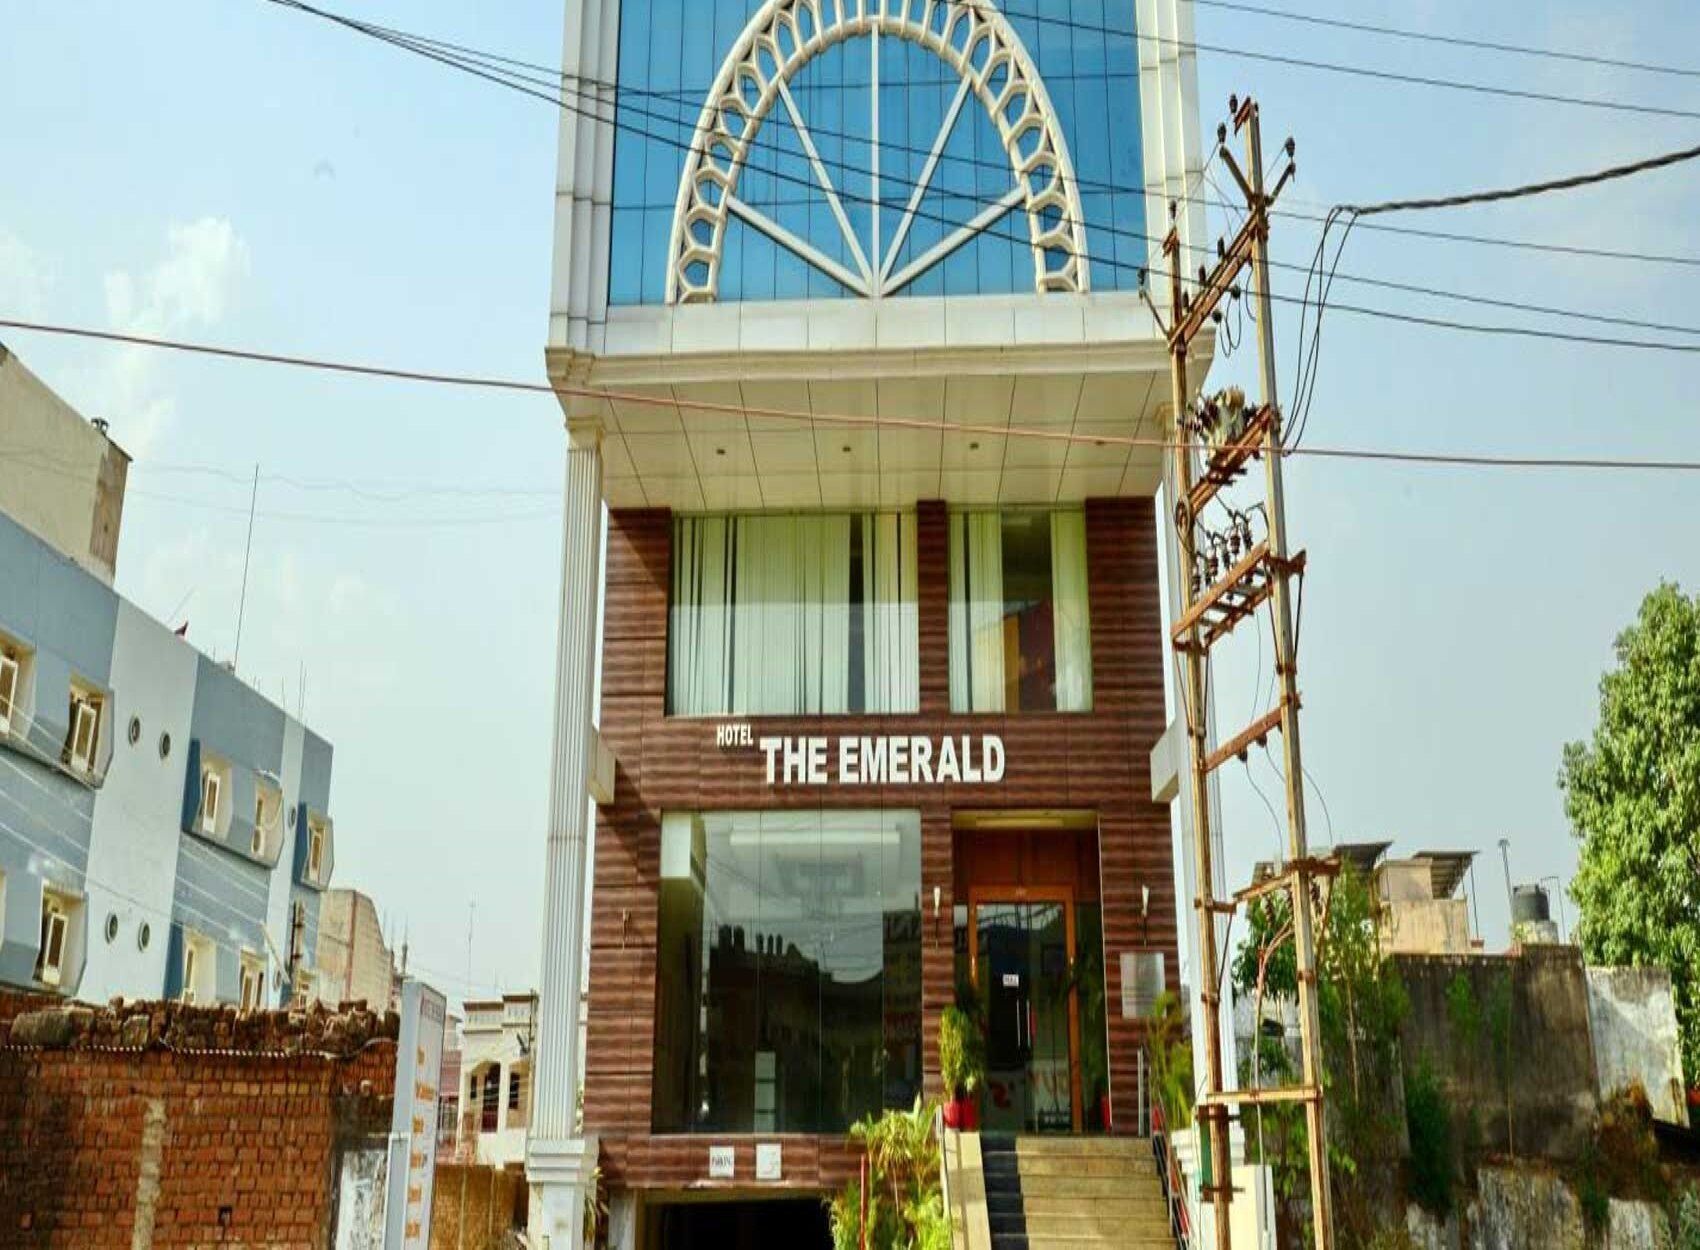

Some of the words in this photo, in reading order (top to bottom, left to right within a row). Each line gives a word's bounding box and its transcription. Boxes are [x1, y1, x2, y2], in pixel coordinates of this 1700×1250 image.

[716, 723, 754, 749] HOTEL
[759, 735, 828, 785] THE
[838, 734, 1006, 785] EMERALD
